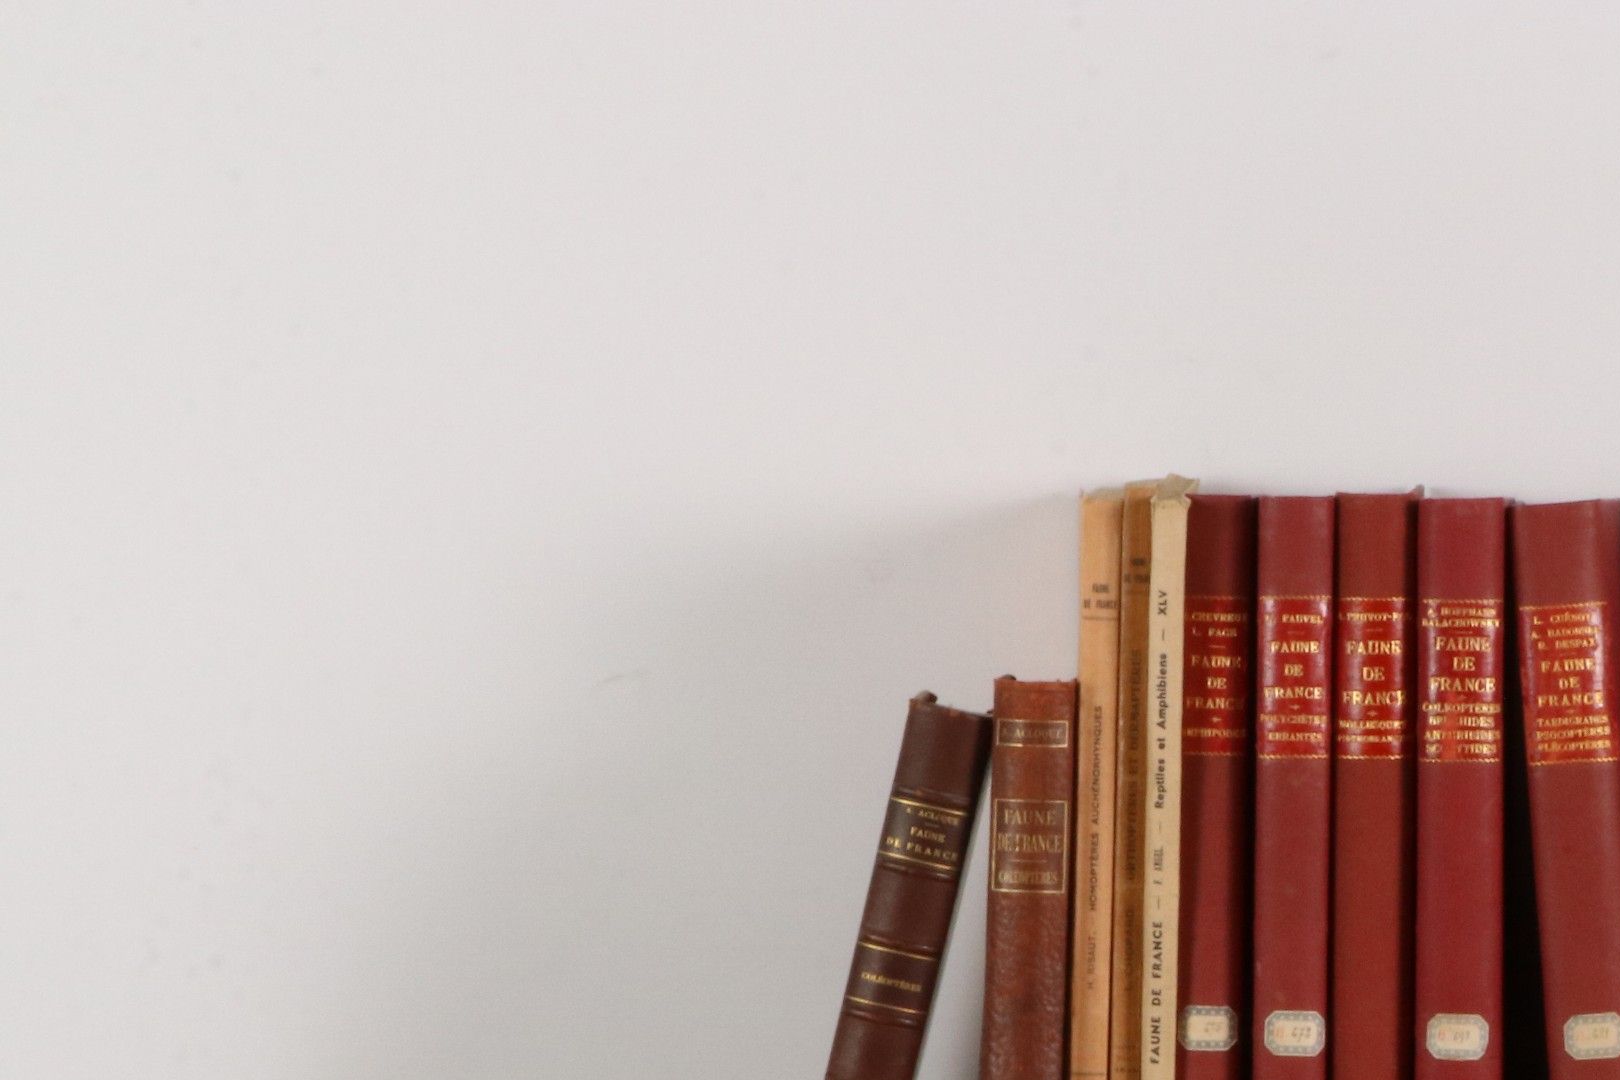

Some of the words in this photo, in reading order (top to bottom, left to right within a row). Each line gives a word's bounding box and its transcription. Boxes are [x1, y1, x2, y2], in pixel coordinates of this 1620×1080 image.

[1158, 591, 1167, 615] XLV
[1434, 635, 1493, 653] FAUNE
[1453, 657, 1475, 671] DE
[1156, 654, 1168, 729] Amphibiens
[1429, 677, 1495, 694] FRANCE
[1154, 759, 1166, 809] Reptiles
[1004, 809, 1057, 825] FAUNE
[1152, 923, 1162, 978] FRANCE
[1151, 990, 1161, 1006] DE
[1150, 1018, 1161, 1064] FAUNE
